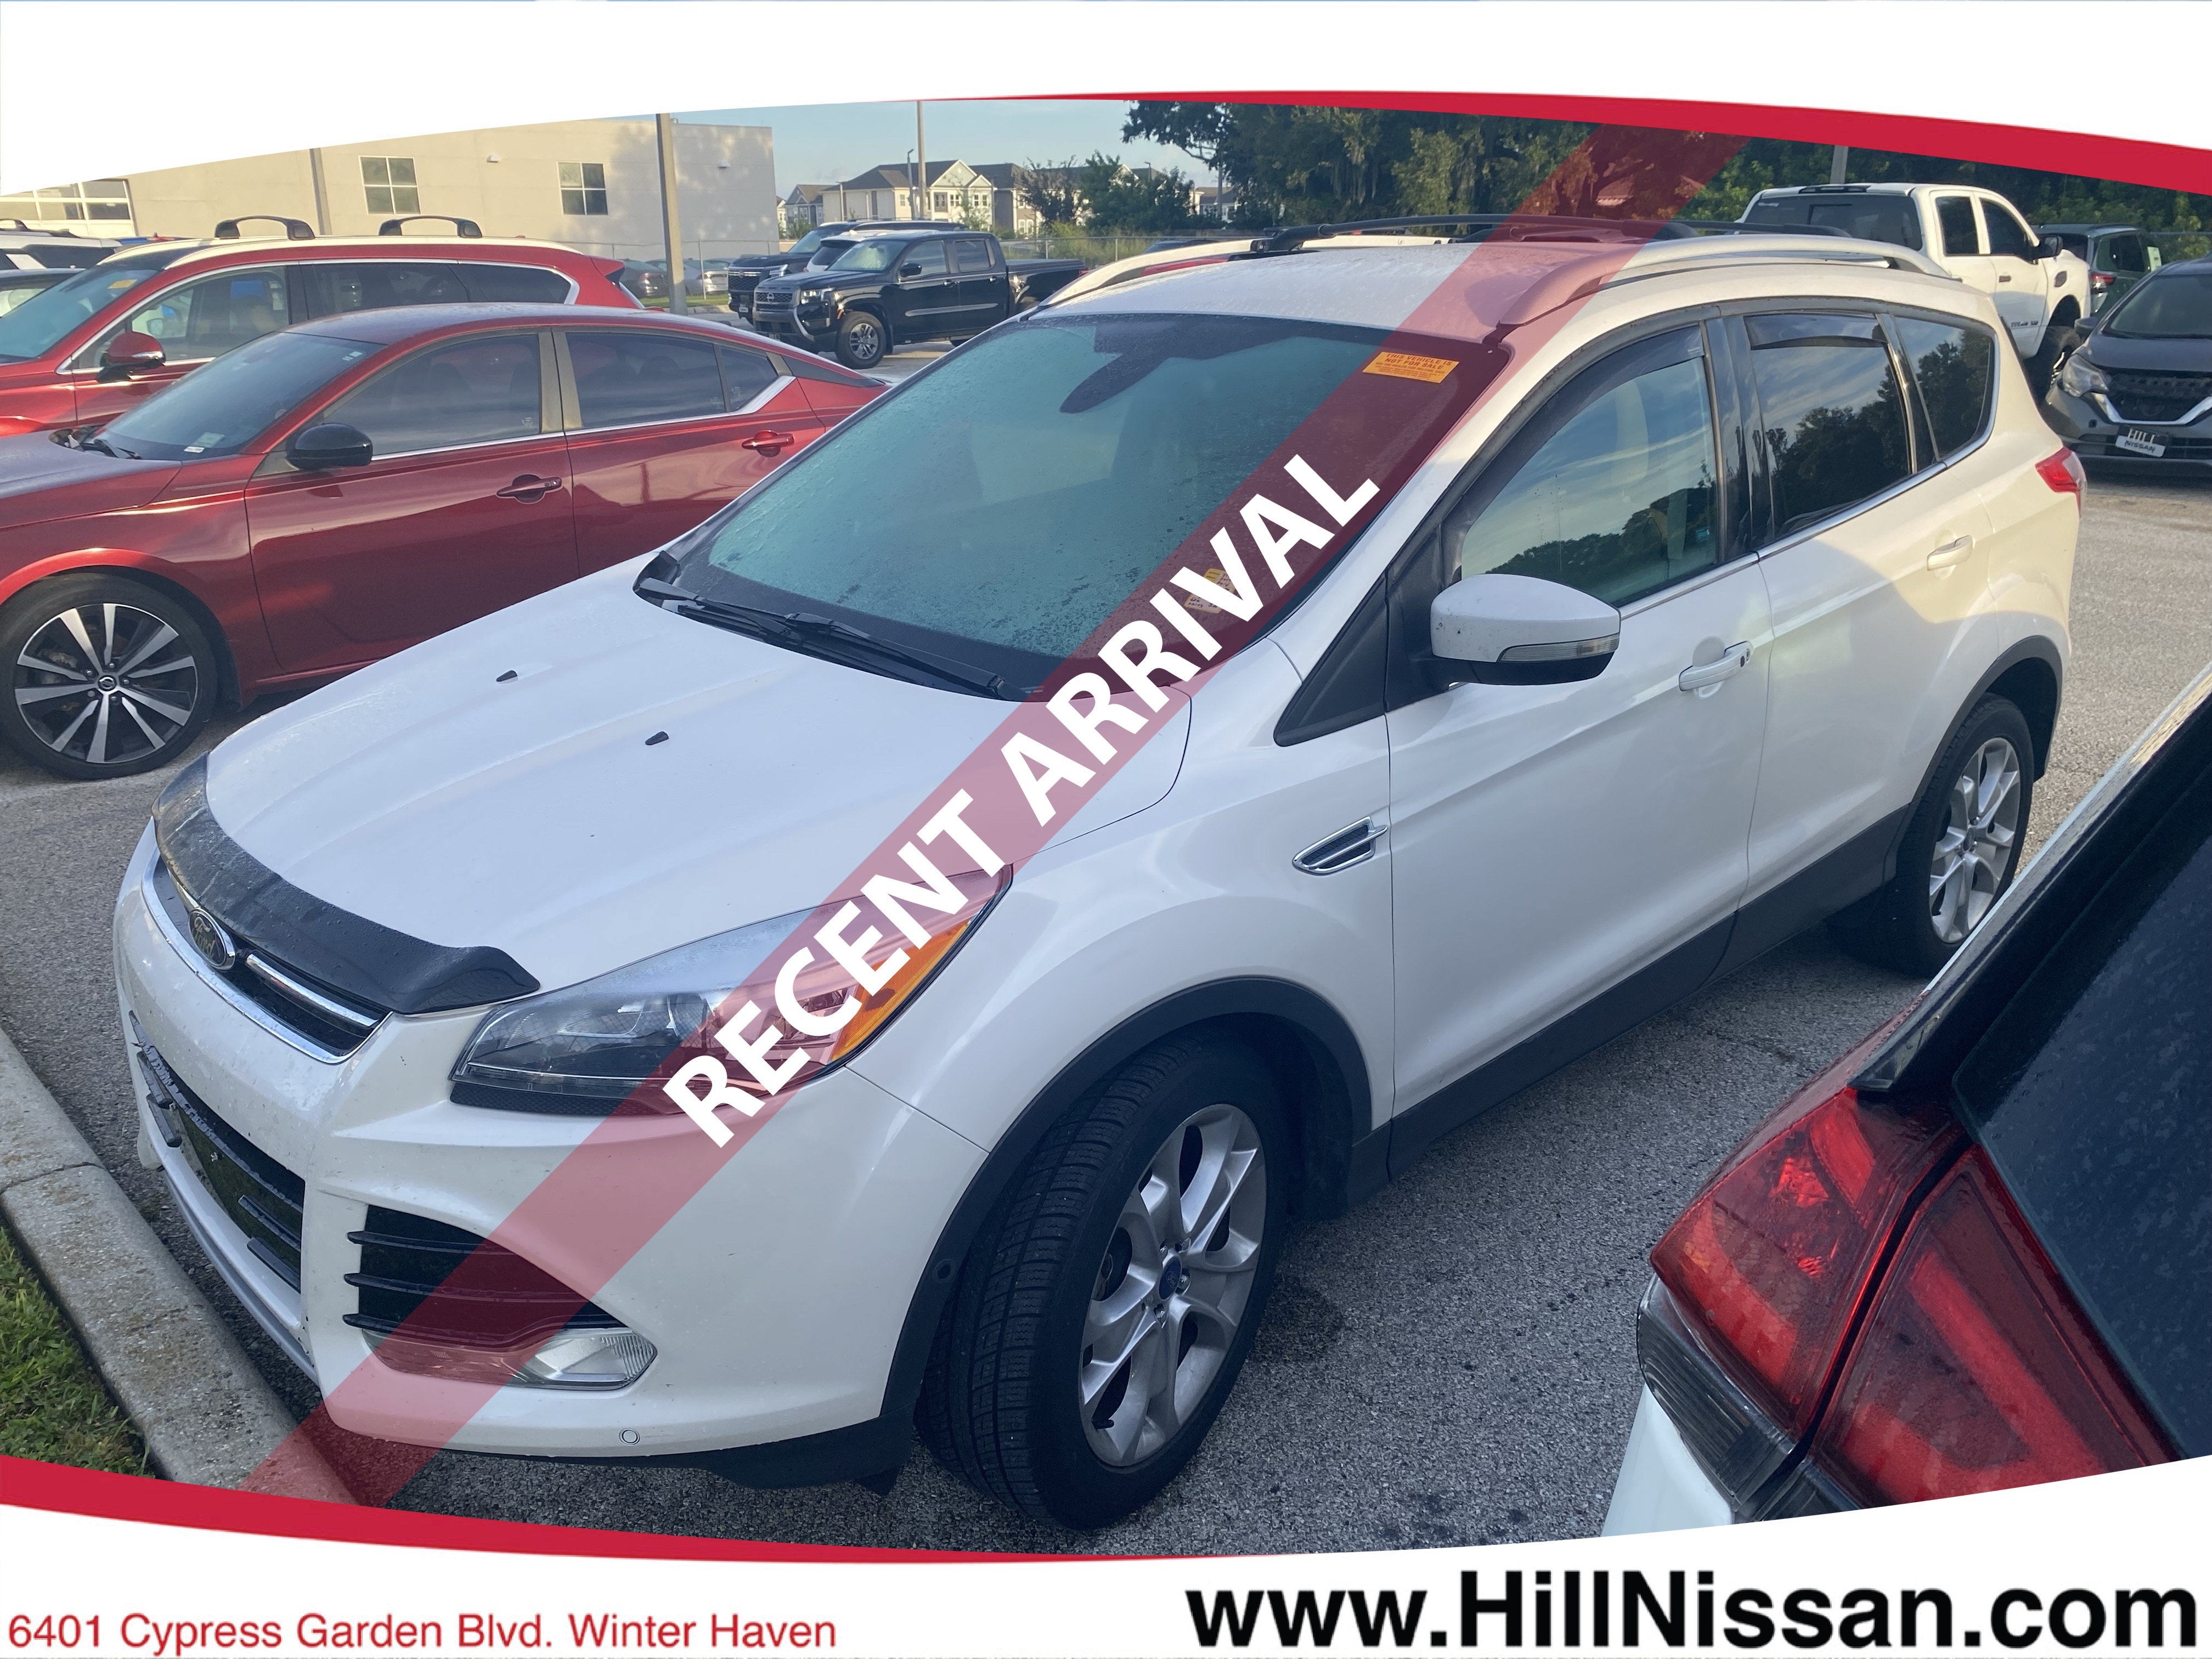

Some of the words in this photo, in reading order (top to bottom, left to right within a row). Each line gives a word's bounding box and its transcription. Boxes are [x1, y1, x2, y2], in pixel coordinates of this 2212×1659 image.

[1406, 356, 1442, 364] VEHICLE
[2128, 428, 2155, 444] HILL
[2124, 440, 2155, 453] NISSAN
[194, 916, 216, 959] Ford
